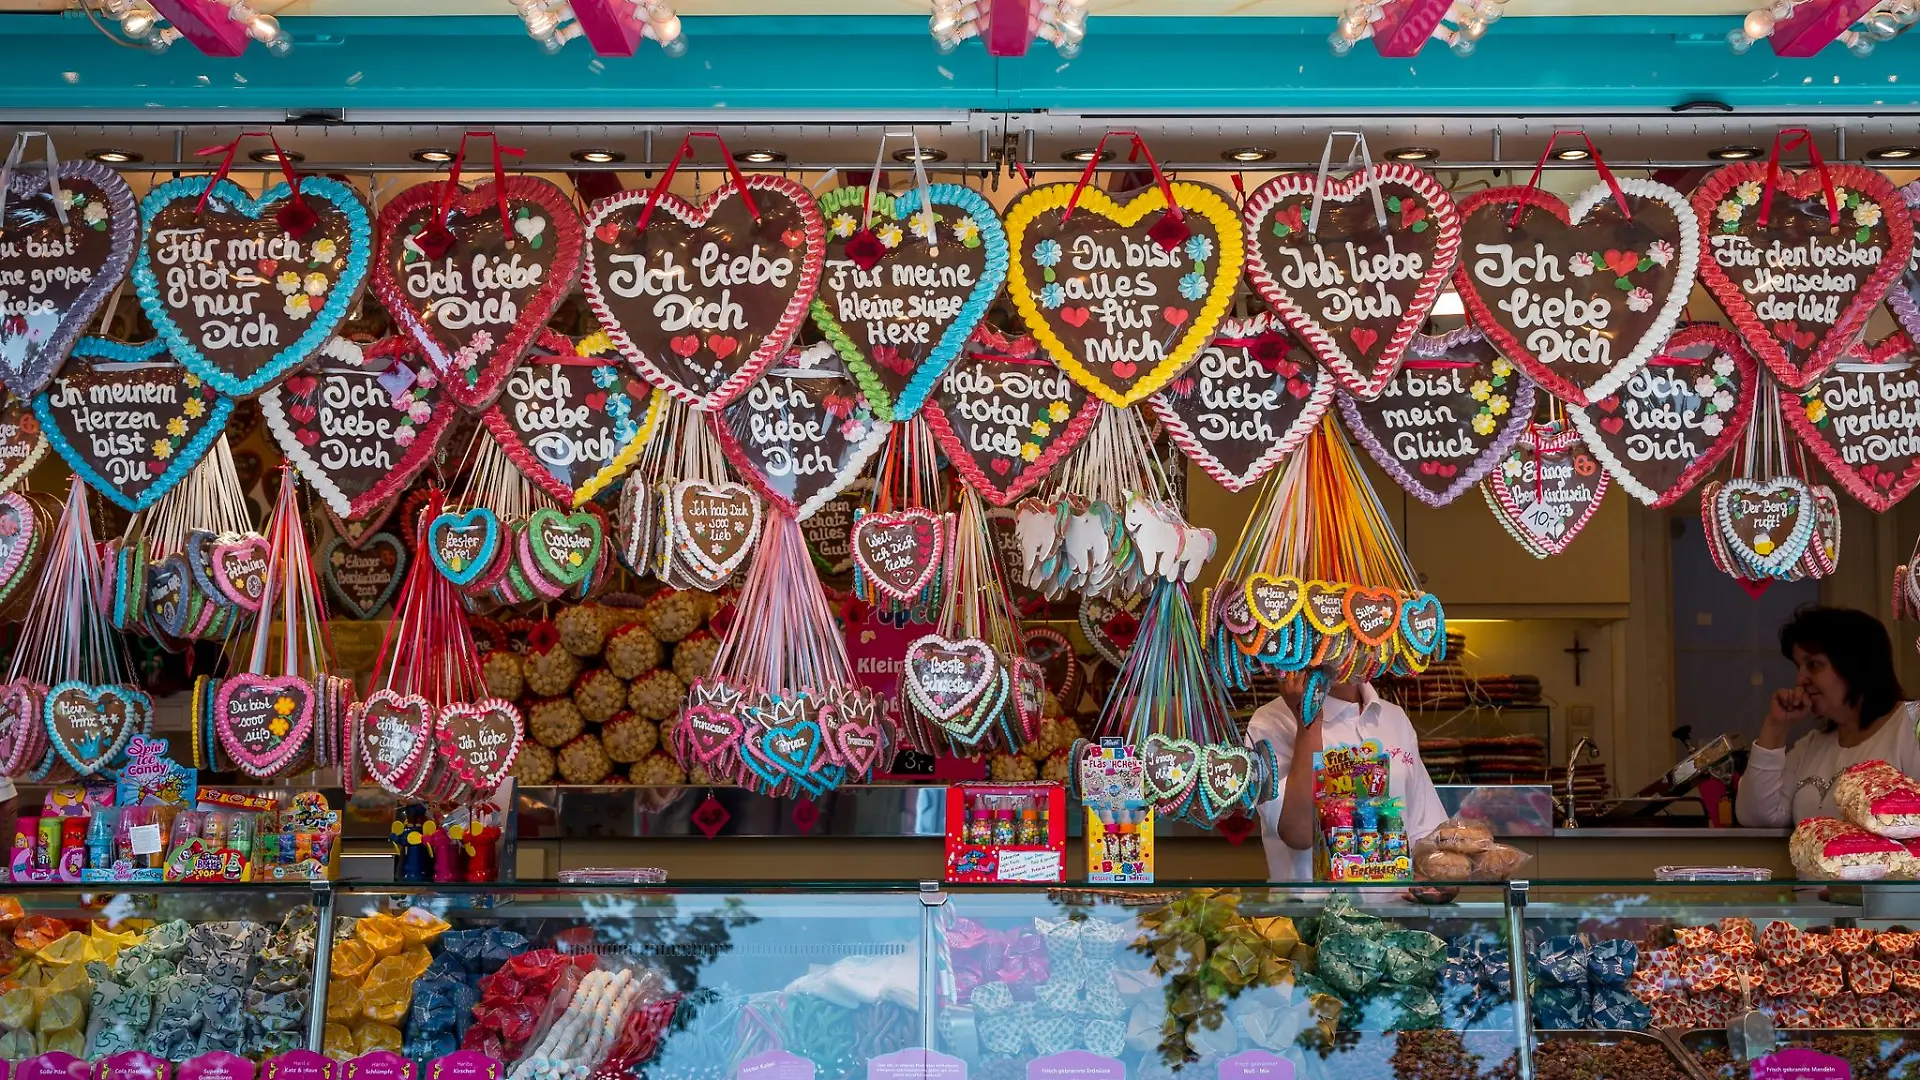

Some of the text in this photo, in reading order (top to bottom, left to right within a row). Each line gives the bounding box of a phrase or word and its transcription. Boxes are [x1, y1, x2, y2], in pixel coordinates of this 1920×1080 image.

[26, 235, 75, 258] bist
[155, 229, 305, 264] Für mich
[1071, 235, 1182, 270] Du bist
[1278, 234, 1424, 289] Ich liebe
[1711, 235, 1759, 267] Für
[1765, 236, 1807, 268] den
[1809, 236, 1883, 267] besten
[404, 253, 543, 298] Ich liebe
[608, 242, 793, 297] Ich liebe
[825, 259, 976, 290] Für meine
[1475, 242, 1565, 288] Ich
[1065, 272, 1158, 299] alles
[1742, 267, 1857, 295] Menschen
[192, 292, 260, 318] nur
[433, 290, 518, 329] Dich
[653, 289, 749, 332] Dich
[834, 290, 963, 325] kleine süße
[1089, 296, 1159, 336] für
[1316, 281, 1402, 323] Dich
[1498, 287, 1612, 330] liebe
[1756, 294, 1841, 325] der Welt
[200, 313, 280, 350] Dich
[867, 320, 930, 346] Hexe
[1526, 327, 1612, 366] Dich
[1084, 332, 1168, 363] mich
[1200, 347, 1273, 379] Ich
[50, 379, 177, 408] In meinem
[323, 375, 390, 410] Ich
[506, 363, 573, 400] Ich
[747, 378, 815, 412] Ich
[1000, 368, 1073, 402] Dich
[1200, 377, 1281, 410] liebe
[1384, 368, 1466, 398] u bist
[1627, 367, 1694, 399] Ich
[1822, 371, 1920, 411] Ich bin
[73, 406, 161, 433] Herzen
[320, 406, 394, 440] liebe
[514, 398, 594, 433] liebe
[955, 393, 1031, 429] total
[1197, 411, 1280, 441] Dich
[1382, 400, 1457, 429] mein
[1625, 403, 1704, 432] liebe
[750, 412, 826, 444] liebe
[90, 431, 146, 458] bist
[320, 436, 394, 470] Dich
[528, 426, 615, 467] Dich
[1393, 427, 1480, 461] Glück
[1625, 432, 1705, 462] Dich
[1840, 428, 1920, 464] in Dich
[105, 457, 152, 485] Du
[762, 445, 838, 477] Dich
[689, 500, 749, 516] Ich hab Dich
[1741, 499, 1788, 518] Der Berg
[1753, 516, 1781, 529] ruft!
[446, 531, 480, 549] Bester
[544, 530, 592, 548] Coolster
[709, 529, 732, 541] lieb
[866, 531, 892, 548] Weil
[883, 554, 914, 573] liebe
[930, 656, 966, 675] Beste
[230, 696, 273, 714] Du bist
[458, 726, 508, 750] Ich liebe
[1089, 745, 1136, 760] BABY
[128, 763, 169, 777] Candy
[469, 748, 498, 765] Dich
[364, 1068, 394, 1076] Schlümpfe
